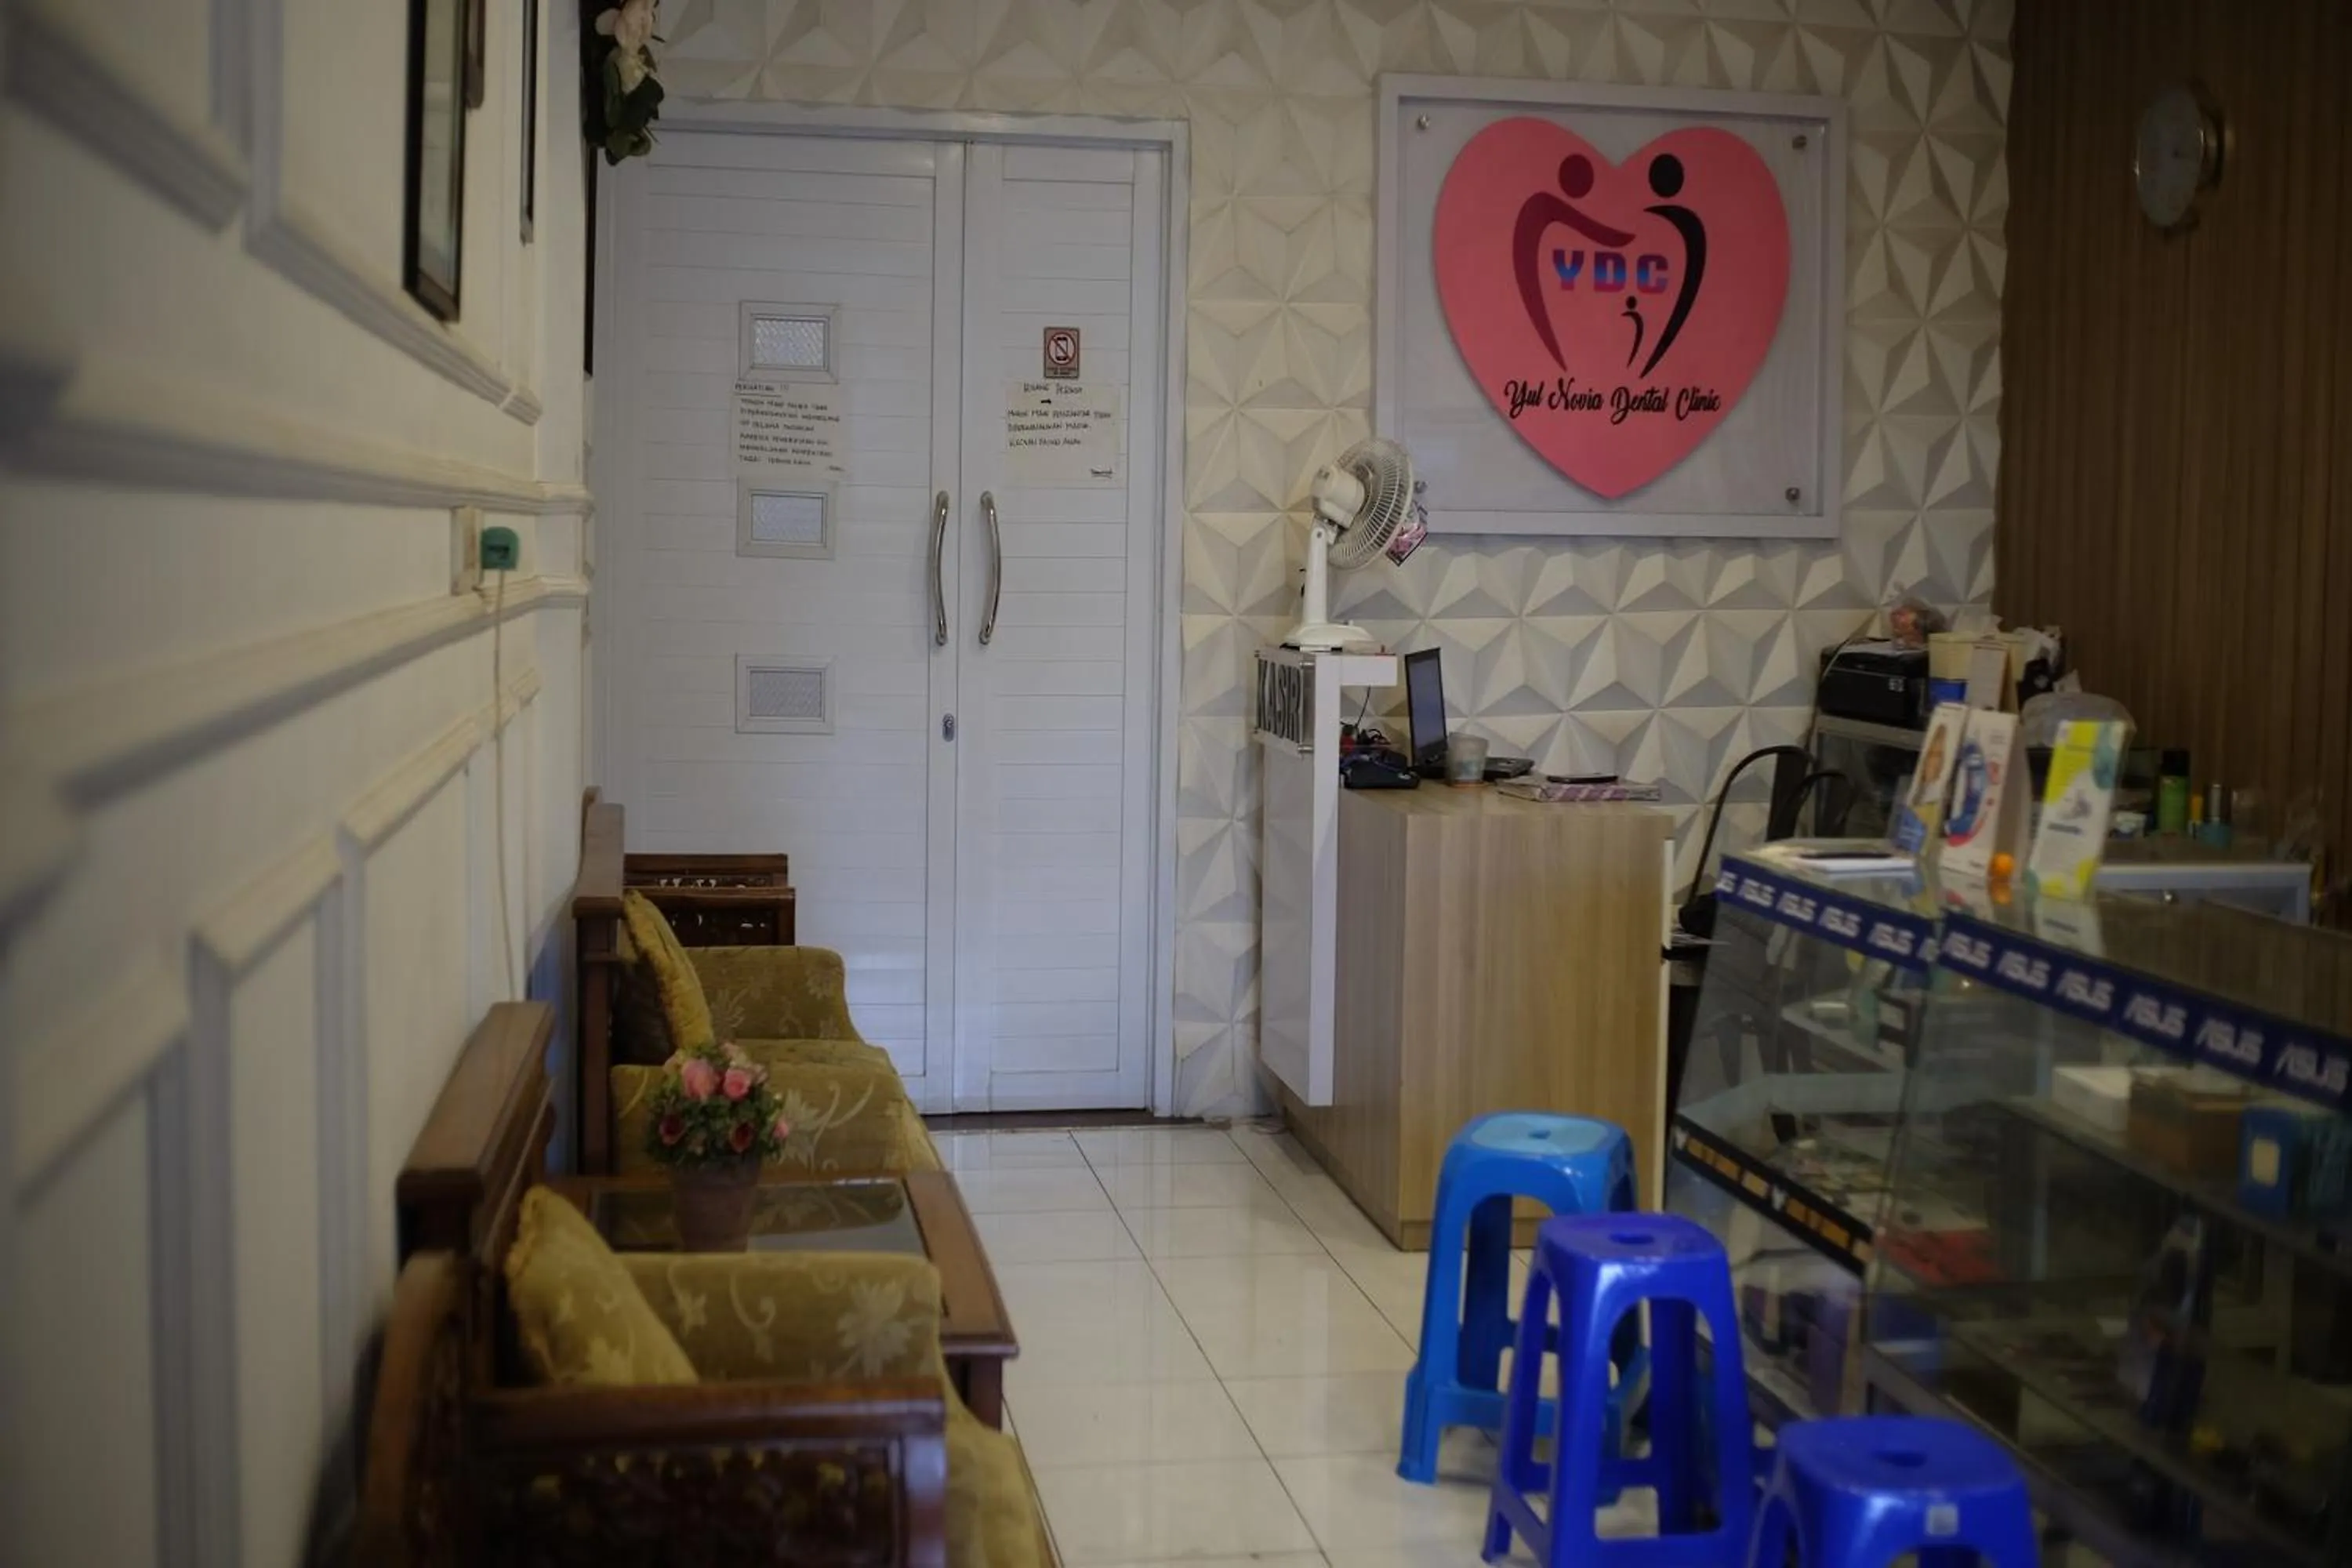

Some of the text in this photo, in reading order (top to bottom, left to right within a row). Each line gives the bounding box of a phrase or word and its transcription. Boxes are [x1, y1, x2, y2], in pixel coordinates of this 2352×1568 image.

[1552, 248, 1668, 293] YDC
[1504, 376, 1721, 424] Yul Novia Dental Clinic
[2056, 969, 2115, 1012] ASUS
[2123, 993, 2188, 1040] ASUS
[2195, 1017, 2264, 1066] ASUS
[2274, 1042, 2350, 1096] ASUS
